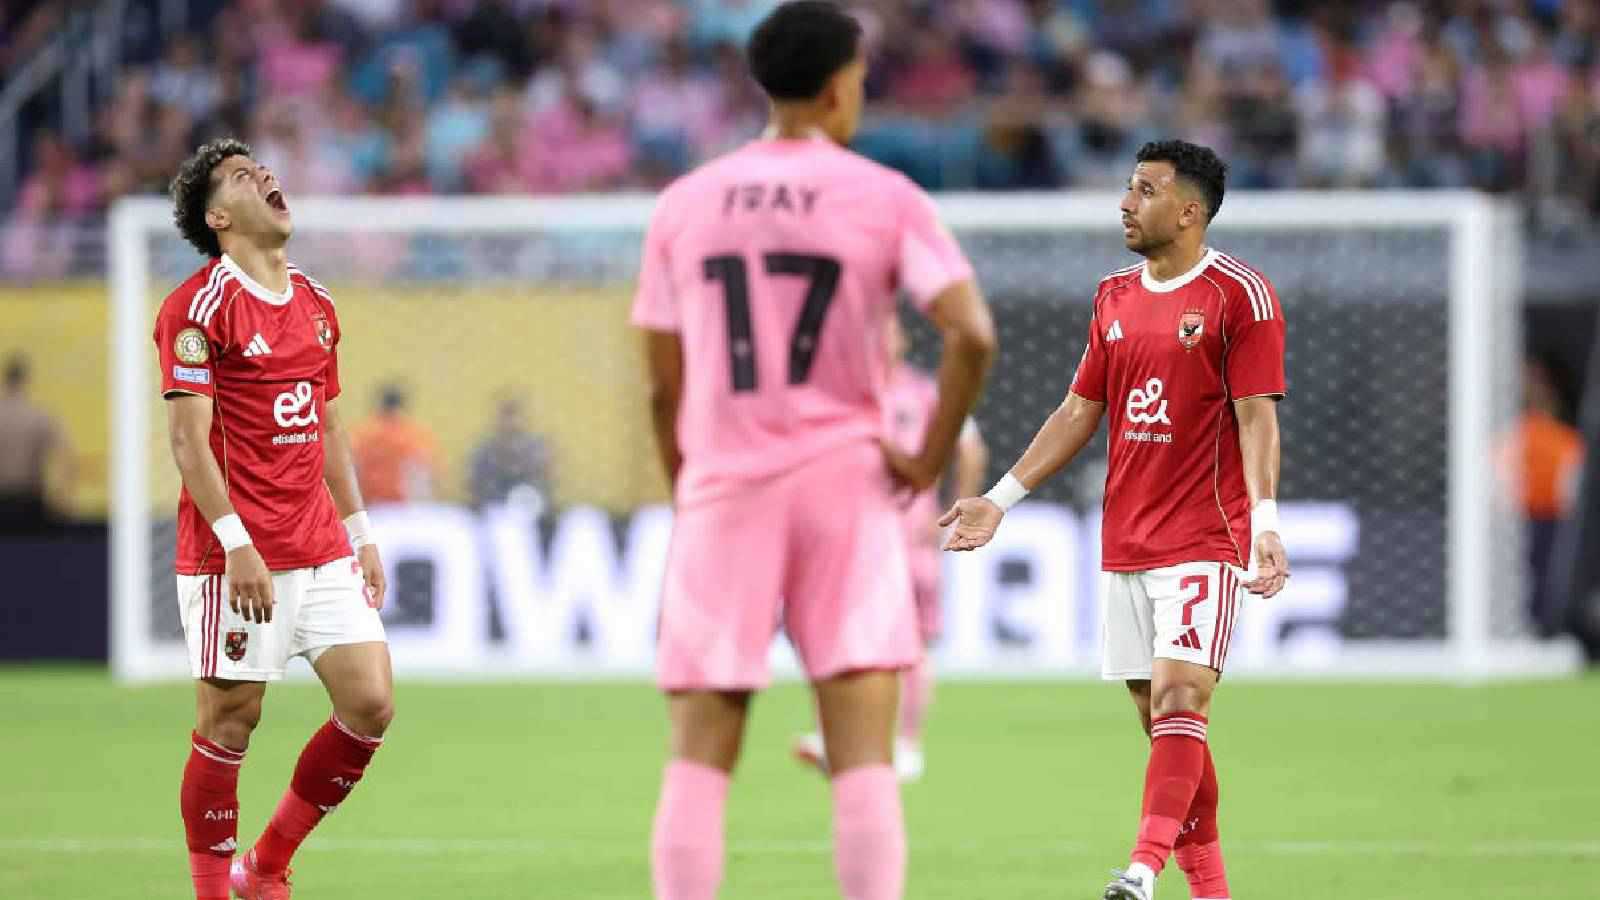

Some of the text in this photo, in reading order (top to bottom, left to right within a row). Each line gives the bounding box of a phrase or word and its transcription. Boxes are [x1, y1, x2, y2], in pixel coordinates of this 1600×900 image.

[702, 252, 843, 393] 17
[1179, 574, 1209, 626] 7
[204, 808, 237, 821] AHL
